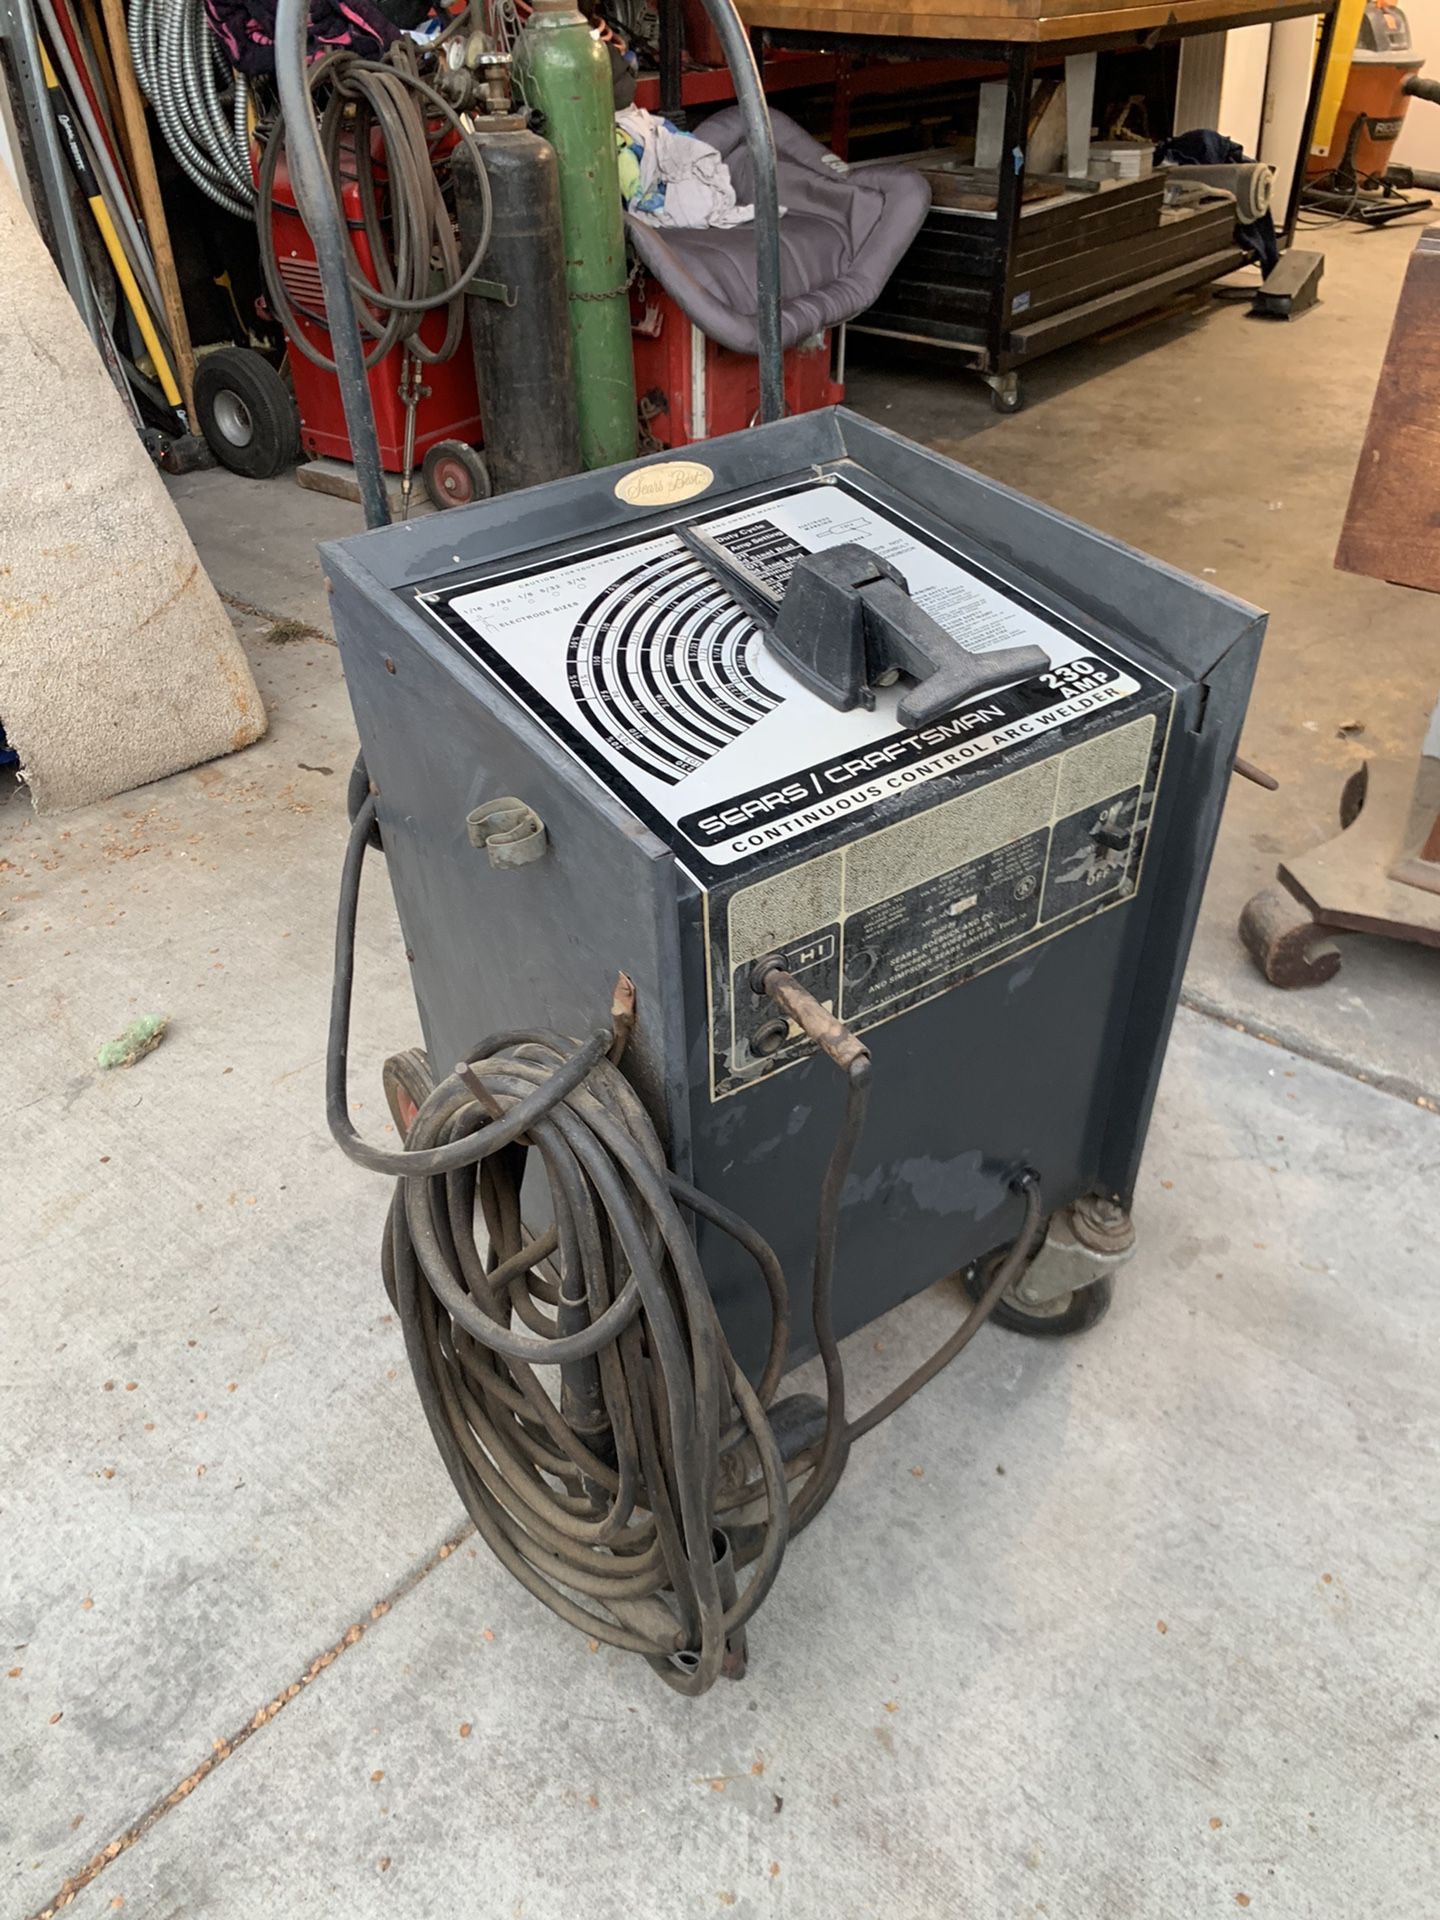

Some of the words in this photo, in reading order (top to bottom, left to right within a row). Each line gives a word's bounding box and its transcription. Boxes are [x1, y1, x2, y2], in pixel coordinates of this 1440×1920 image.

[626, 478, 663, 500] Sears
[714, 532, 741, 542] Duty
[737, 523, 767, 535] Cycle
[727, 541, 753, 551] Amp
[748, 530, 784, 543] Setting
[498, 609, 552, 628] ELECTRODE
[1038, 660, 1095, 690] 230
[1058, 671, 1109, 700] AMP
[697, 782, 809, 835] SEARS
[824, 704, 1006, 783] CRAFTSMAN
[731, 785, 882, 853] CONTINUOUS
[886, 742, 990, 788] CONTROL
[991, 723, 1034, 745] ARC
[1035, 687, 1120, 726] WELDER
[1086, 867, 1110, 887] OFF
[800, 944, 824, 964] HI
[869, 979, 886, 994] AND
